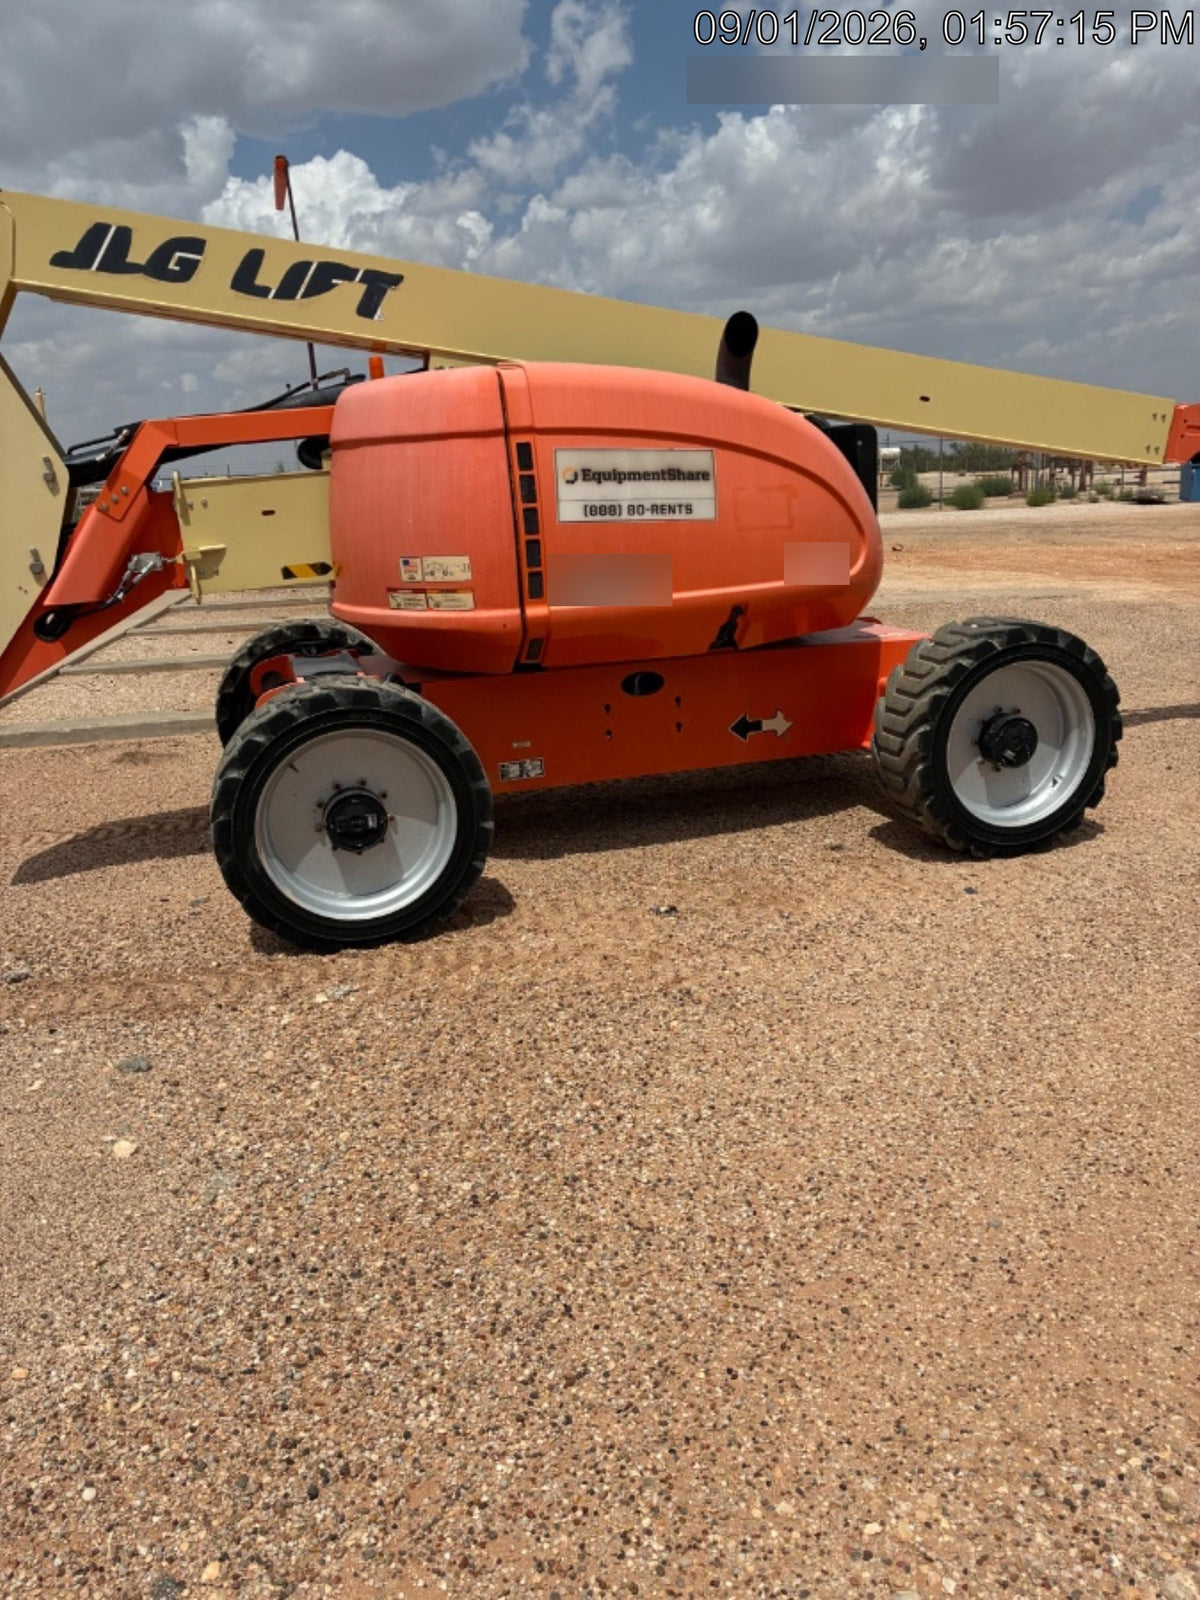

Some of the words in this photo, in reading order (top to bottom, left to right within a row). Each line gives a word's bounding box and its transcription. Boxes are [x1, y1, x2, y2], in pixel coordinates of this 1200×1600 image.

[49, 222, 207, 283] JLG
[230, 248, 404, 320] LIFT
[581, 468, 710, 484] EquipmentShare
[584, 504, 622, 517] (888)
[627, 504, 693, 516] 80-RENTS
